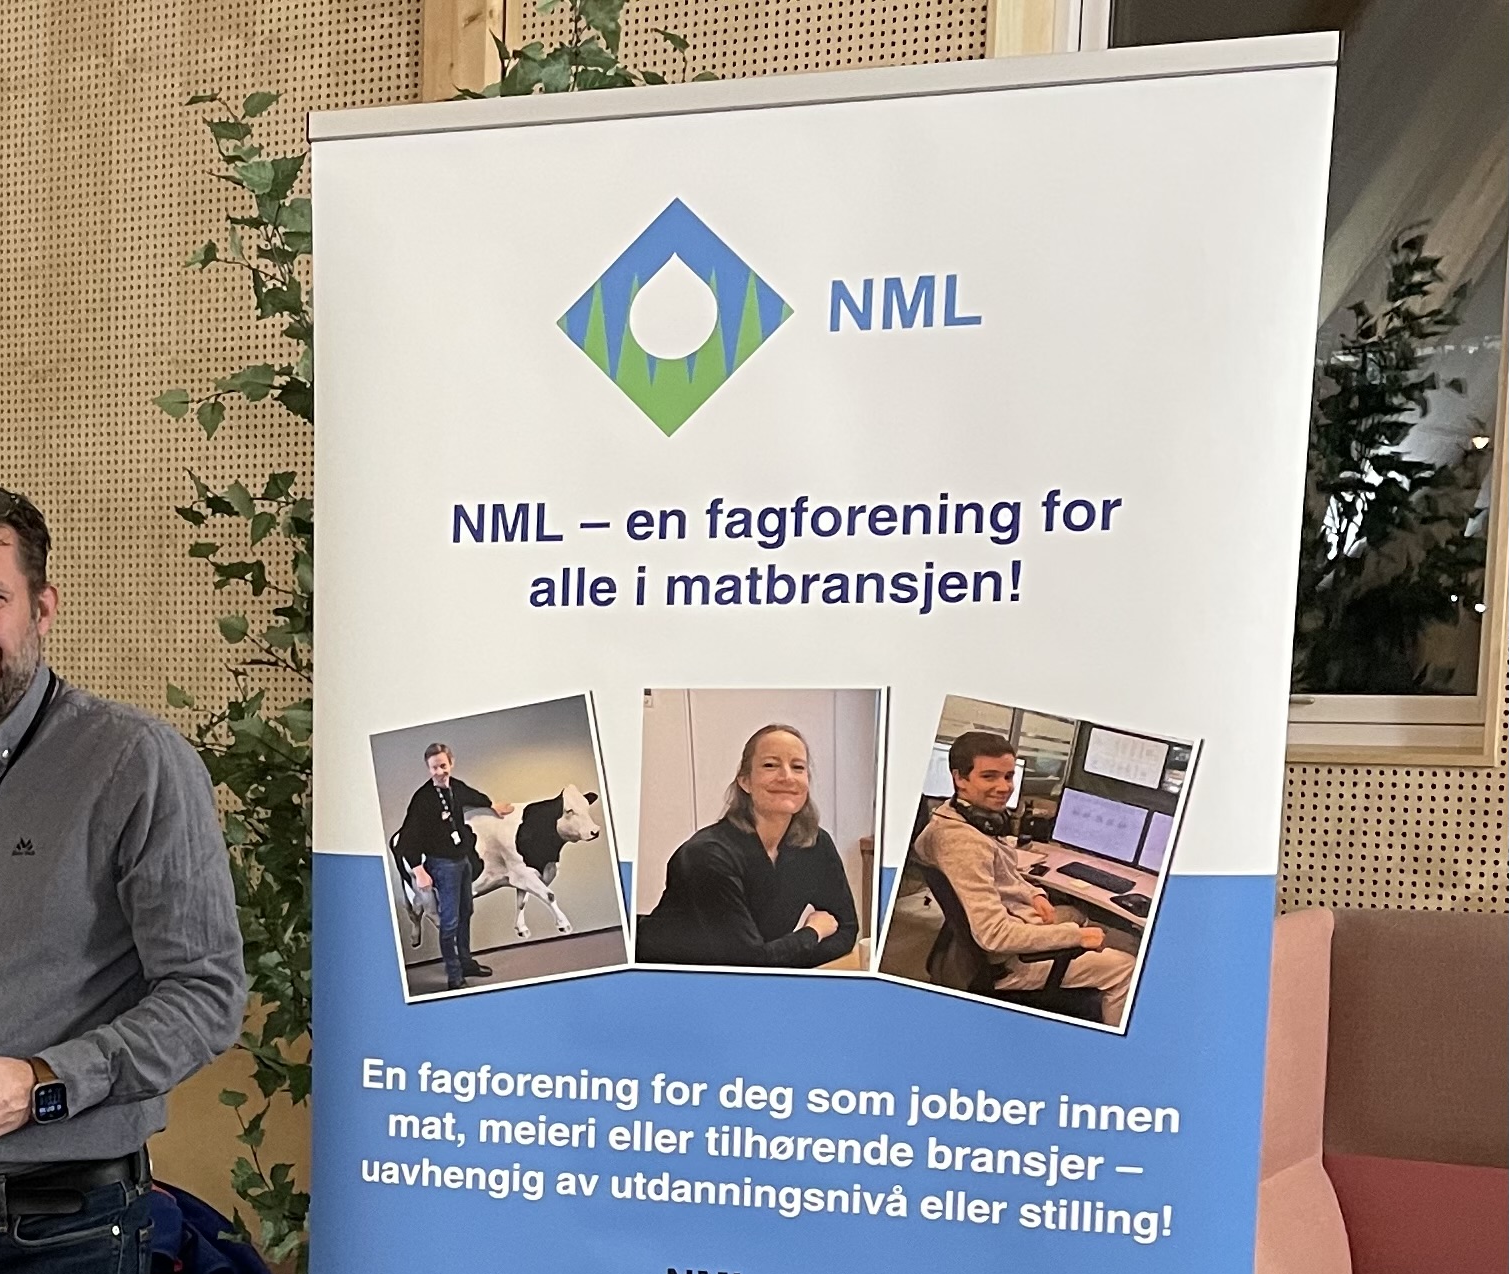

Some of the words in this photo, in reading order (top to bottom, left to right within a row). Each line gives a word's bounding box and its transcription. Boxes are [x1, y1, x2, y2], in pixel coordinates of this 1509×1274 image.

[830, 274, 982, 332] NML
[453, 502, 564, 544] NML
[627, 508, 687, 541] en
[706, 493, 1022, 549] fagforening
[1041, 489, 1123, 532] for
[530, 566, 616, 608] alle
[636, 566, 647, 606] i
[666, 560, 1022, 616] matbransjen!
[362, 1057, 407, 1091] En
[418, 1062, 639, 1111] fagforening
[651, 1073, 707, 1107] for
[719, 1077, 794, 1120] deg
[807, 1088, 895, 1117] som
[907, 1086, 1046, 1127] jobber
[1059, 1095, 1180, 1134] innen
[389, 1112, 466, 1148] mat,
[480, 1115, 596, 1149] meieri
[609, 1120, 695, 1154] eller
[705, 1125, 914, 1168] tilhørende
[928, 1137, 1105, 1187] bransjer
[362, 1158, 544, 1201] uavhengig
[556, 1173, 600, 1197] av
[611, 1171, 908, 1218] utdanningsnivå
[921, 1190, 1008, 1225] eller
[1019, 1199, 1173, 1245] stilling!
